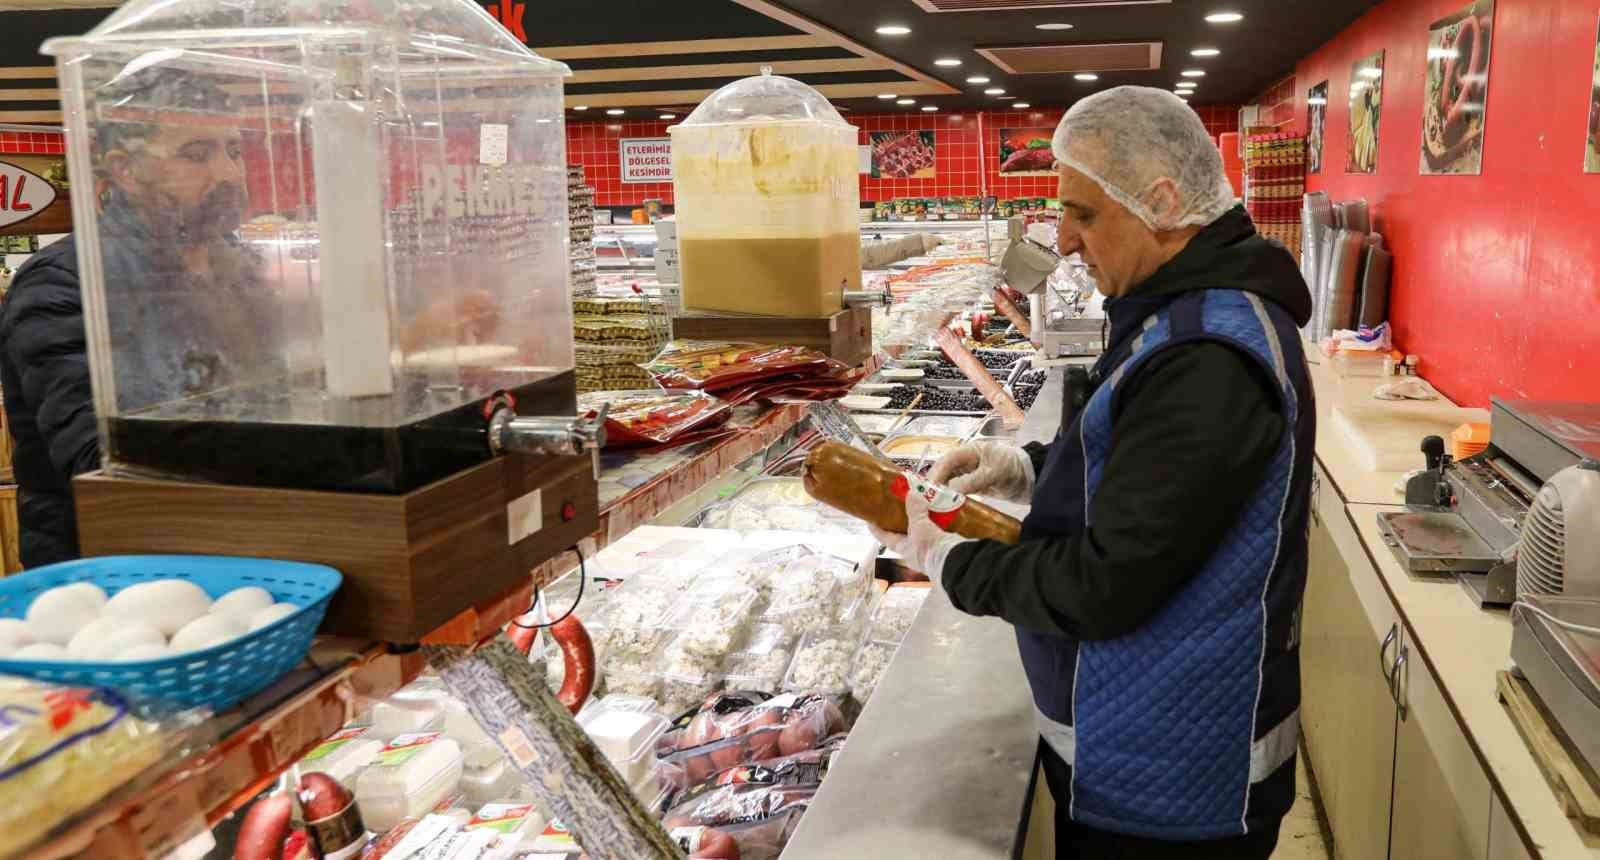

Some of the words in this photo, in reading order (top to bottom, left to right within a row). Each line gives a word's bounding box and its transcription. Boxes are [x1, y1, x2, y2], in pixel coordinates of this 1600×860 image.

[627, 143, 671, 154] ETLERİMİZ
[629, 155, 671, 166] BÖLGESEL
[630, 167, 671, 177] KESİMDİR
